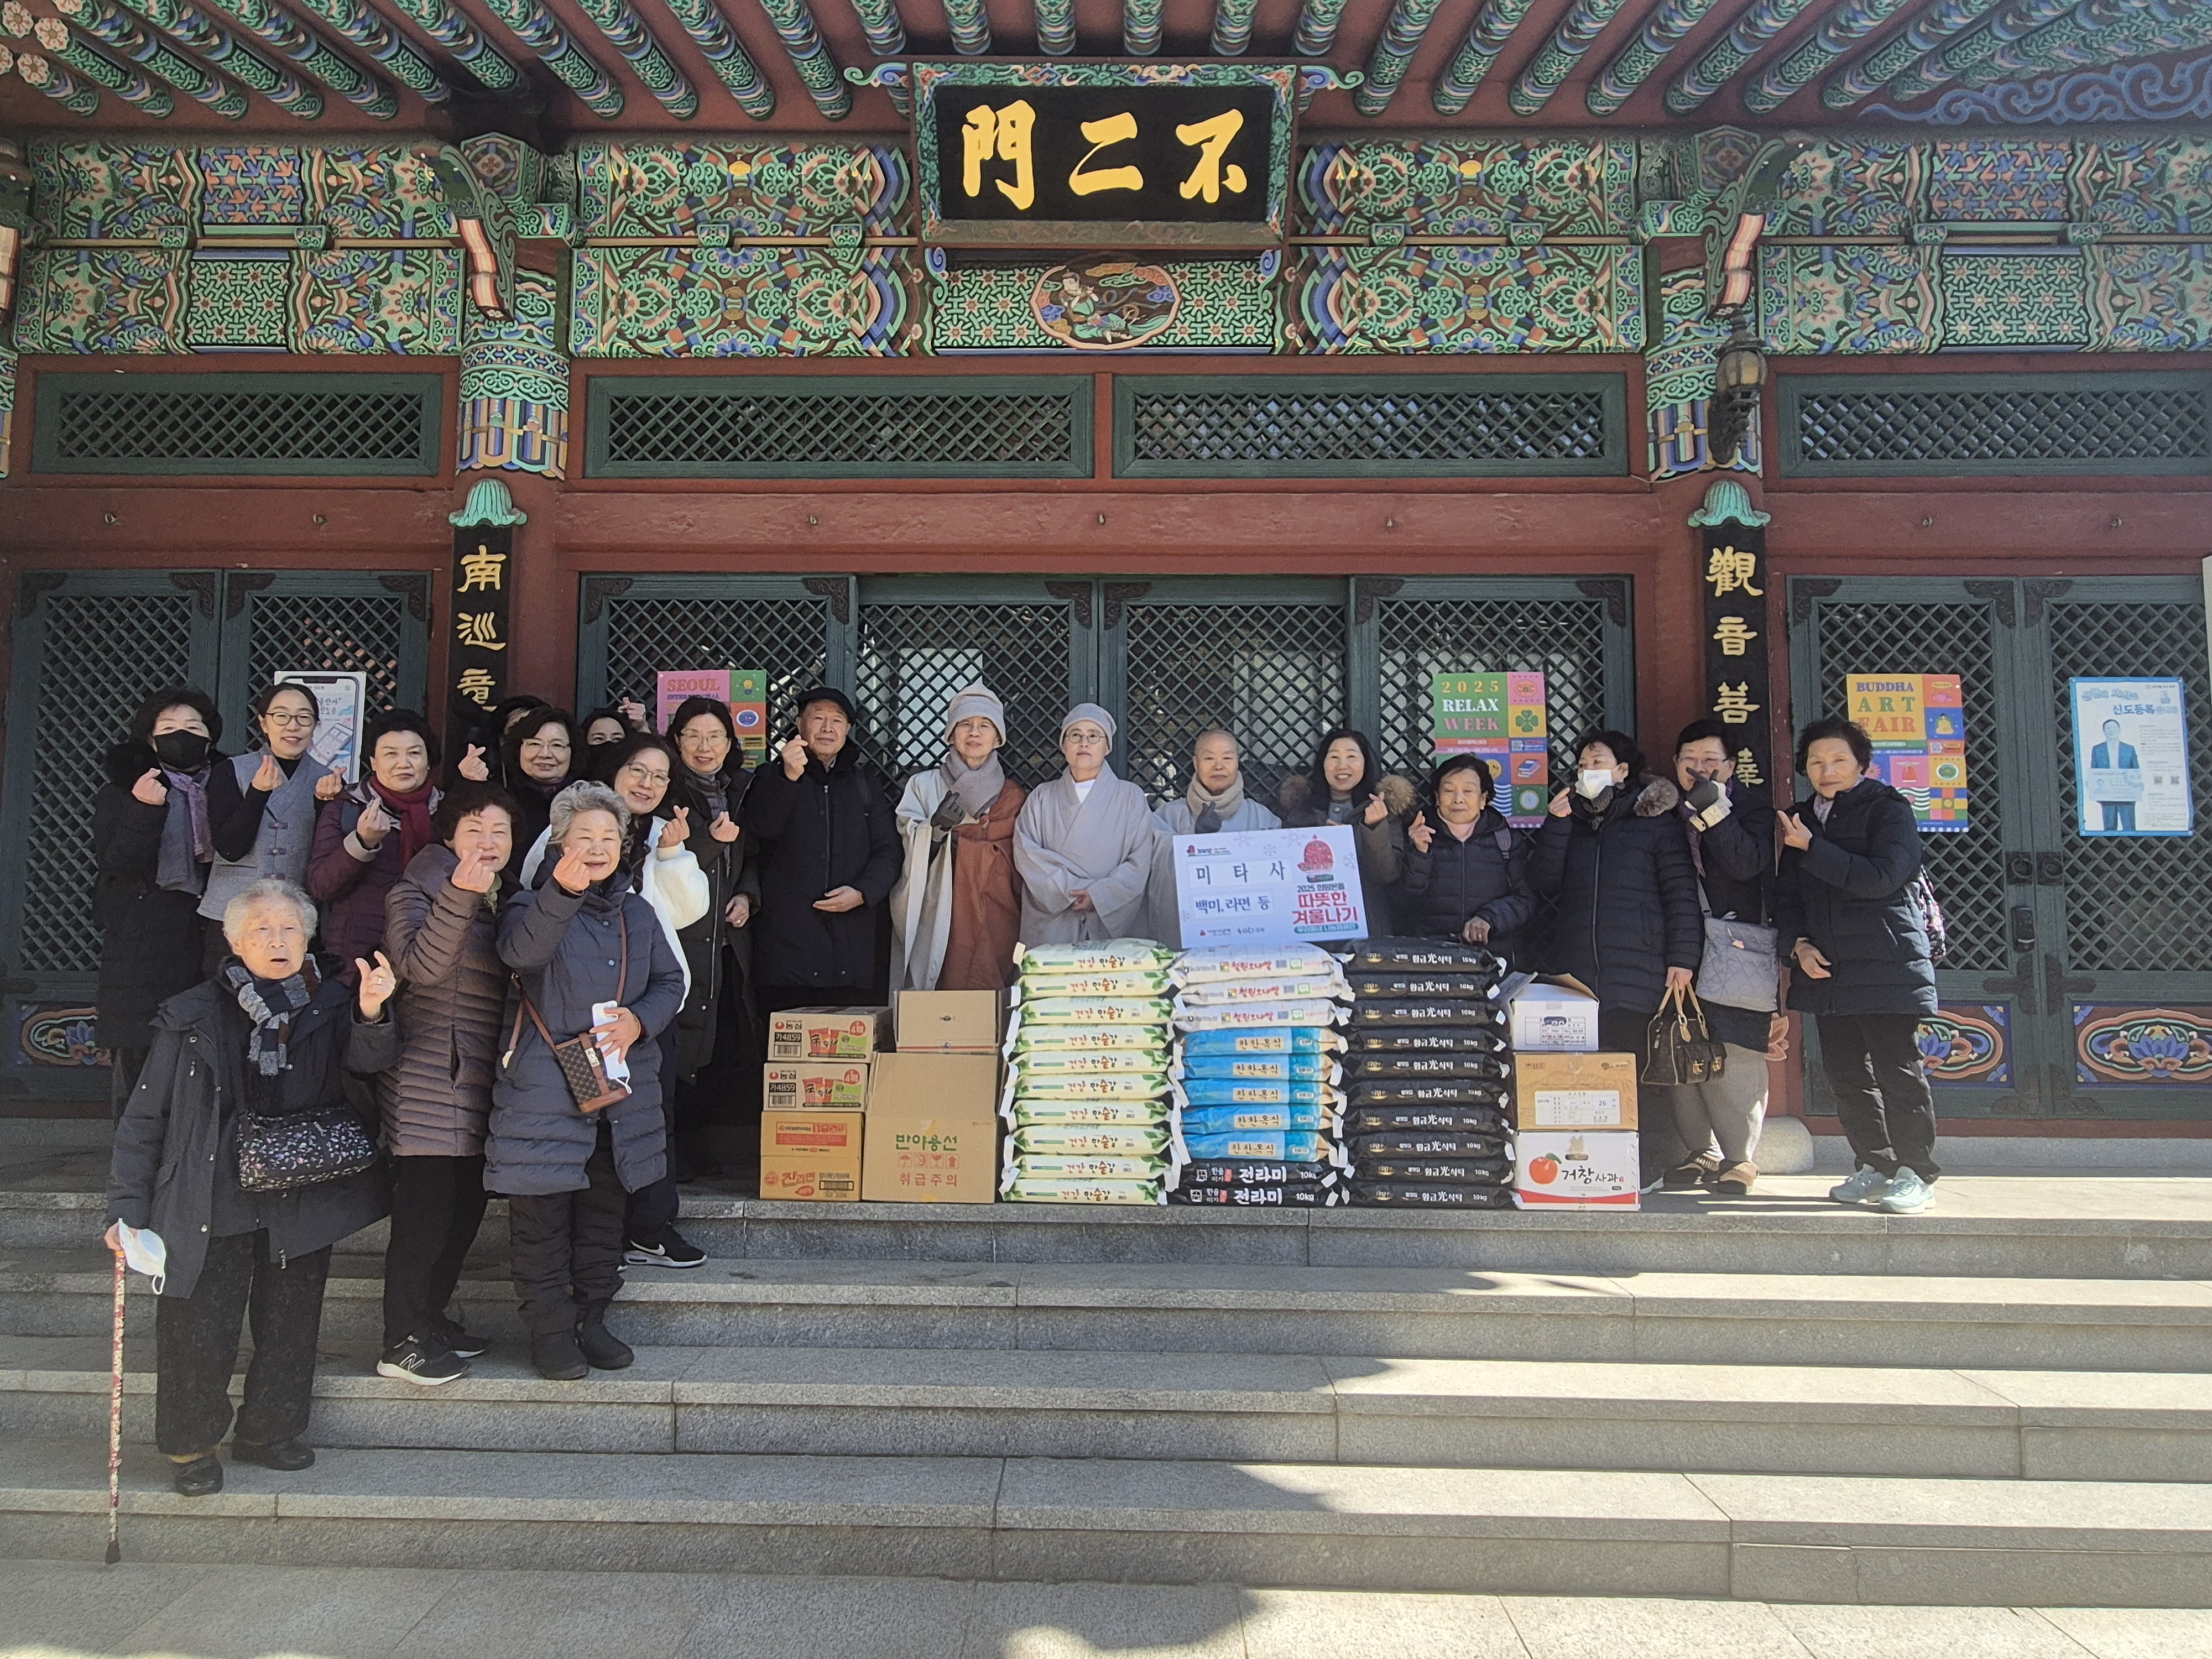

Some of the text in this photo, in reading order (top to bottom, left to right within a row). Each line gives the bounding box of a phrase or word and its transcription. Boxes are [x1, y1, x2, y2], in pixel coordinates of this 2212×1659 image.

[962, 100, 1247, 210] 不二門
[667, 679, 720, 692] SEOUL
[1441, 681, 1499, 693] 2025
[1856, 682, 1914, 692] BUDDHA
[1442, 698, 1500, 712] RELAX
[1858, 697, 1916, 712] ART
[1443, 718, 1500, 731] WEEK
[1857, 717, 1916, 732] FAIR
[1258, 896, 1270, 910] 등
[1298, 891, 1347, 907] 따뜻한
[1292, 906, 1358, 924] 겨울나기
[900, 1172, 957, 1187] 취급주의
[1239, 1166, 1287, 1183] 전라미
[1562, 1165, 1619, 1184] 거창 사과
[1234, 1188, 1314, 1205] 전라미 10kg
